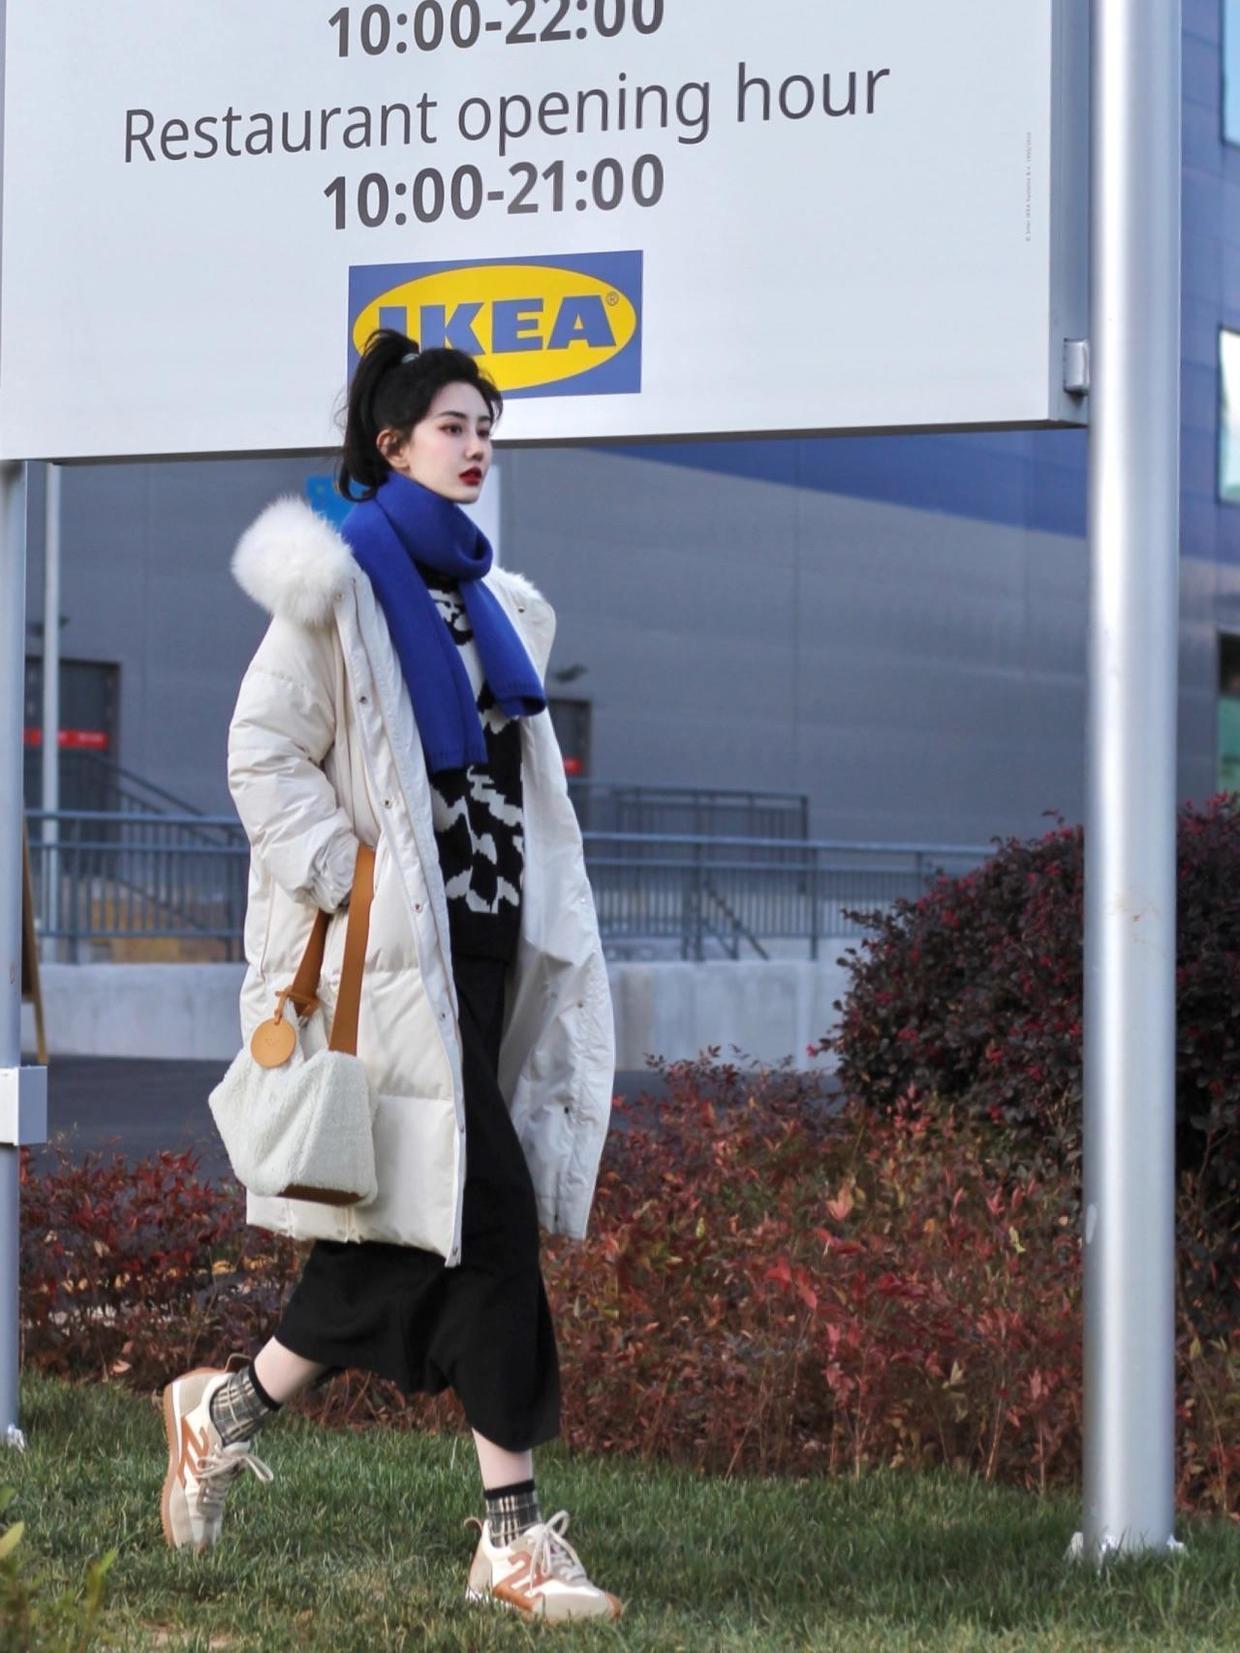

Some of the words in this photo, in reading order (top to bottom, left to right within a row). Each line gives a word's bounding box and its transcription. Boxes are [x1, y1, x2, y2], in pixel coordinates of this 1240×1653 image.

[329, 0, 663, 57] 10:00-22:00
[126, 94, 437, 163] Restaurant
[458, 73, 709, 154] opening
[738, 62, 890, 122] hour
[323, 153, 665, 229] 10:00-21:00
